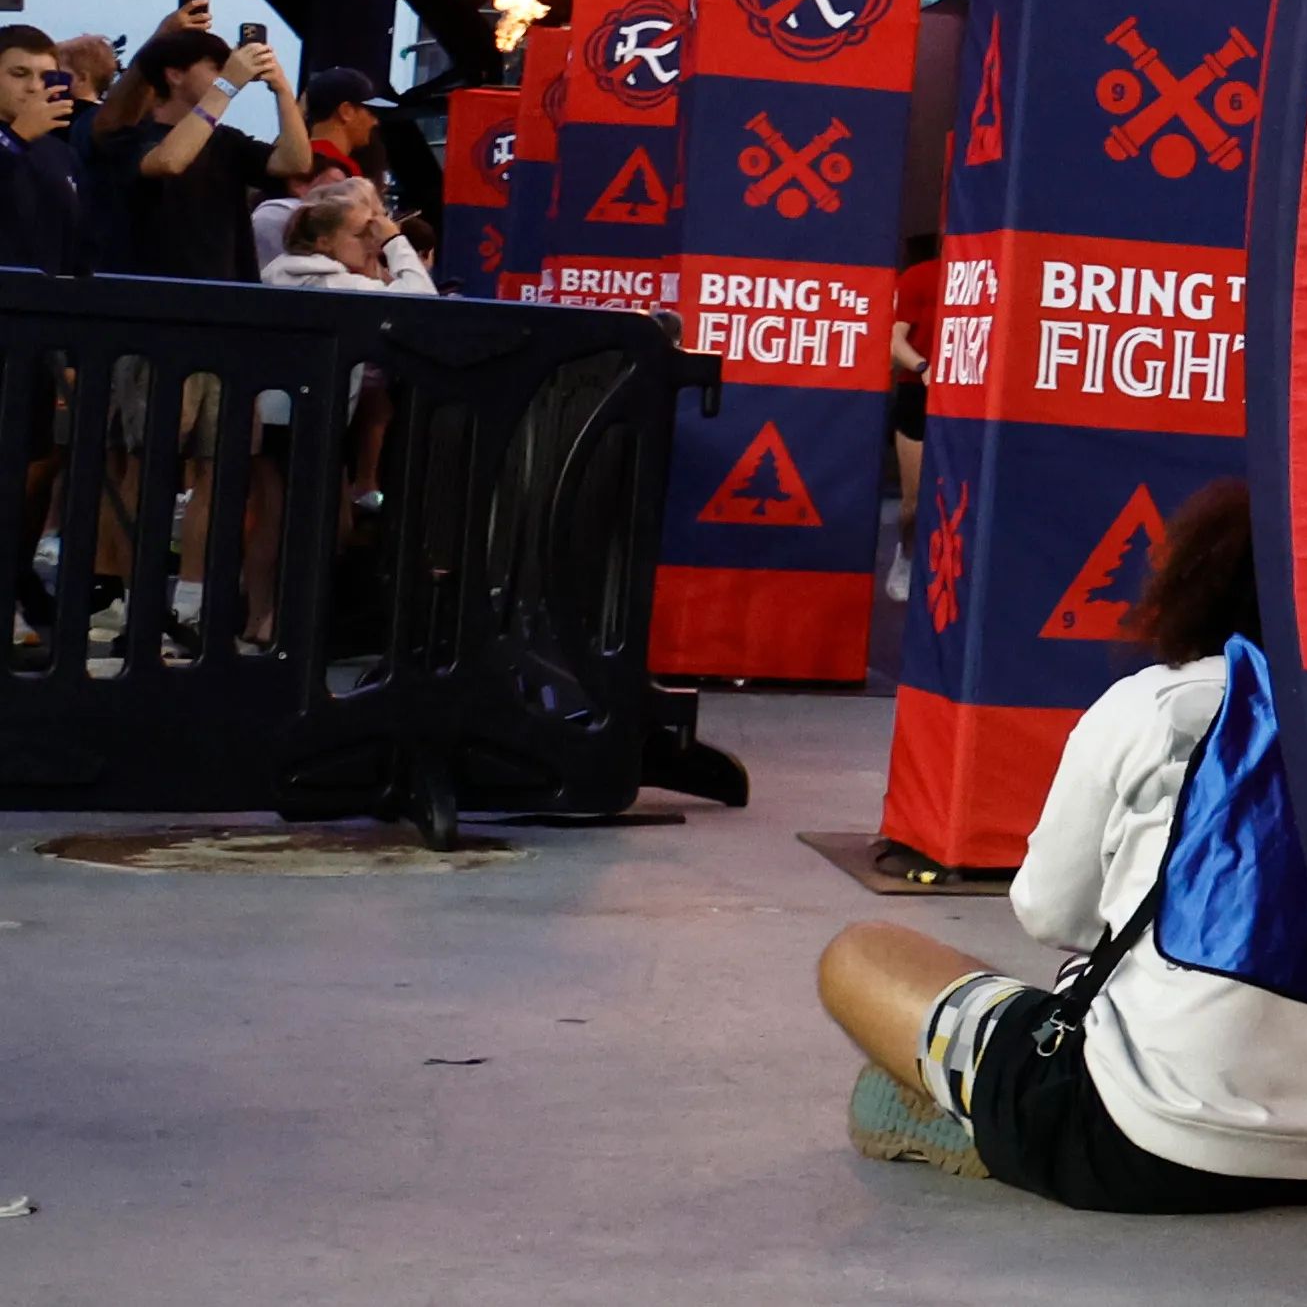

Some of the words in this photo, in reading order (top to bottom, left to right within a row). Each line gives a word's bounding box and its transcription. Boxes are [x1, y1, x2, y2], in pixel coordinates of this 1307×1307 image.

[560, 268, 653, 296] BRING
[699, 273, 820, 311] BRING
[1040, 261, 1215, 320] BRING
[700, 313, 868, 367] FIGHT
[1035, 320, 1246, 402] FIGH
